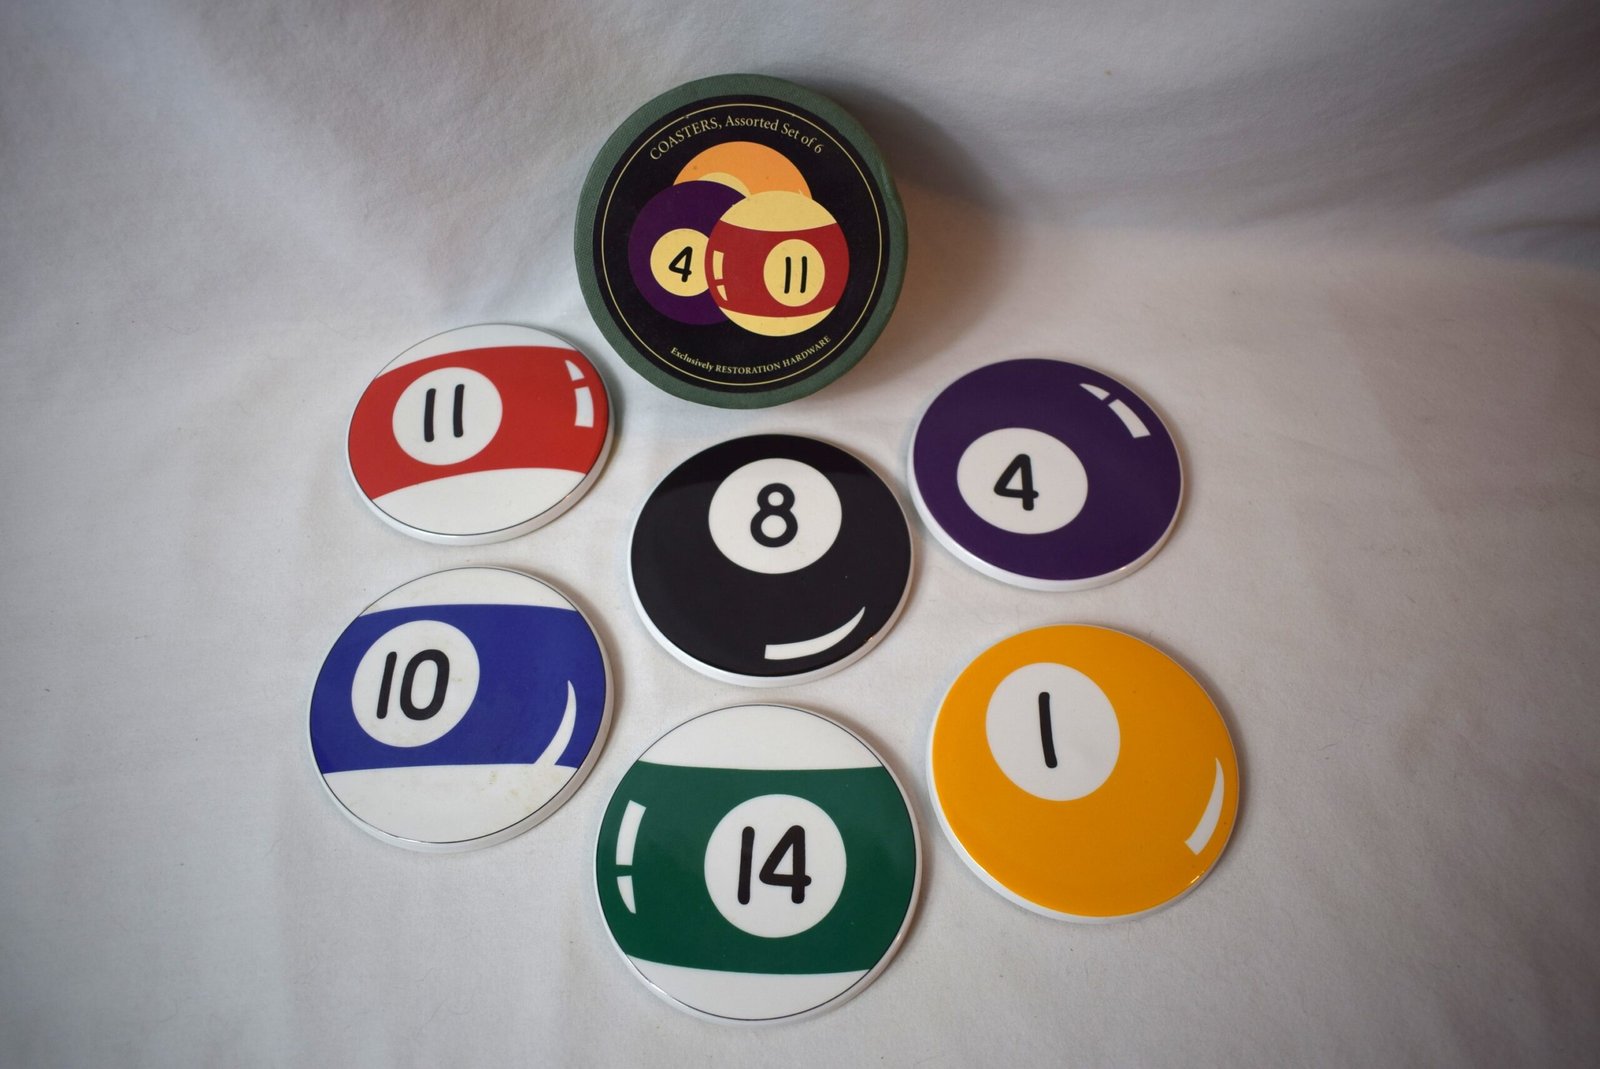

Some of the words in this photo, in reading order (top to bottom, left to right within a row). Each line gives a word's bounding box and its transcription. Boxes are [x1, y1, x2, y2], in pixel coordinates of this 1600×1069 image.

[649, 116, 723, 160] COASTERS,
[725, 115, 779, 131] Assorted
[780, 123, 800, 140] Set
[800, 135, 819, 148] of
[813, 143, 825, 154] 6
[669, 247, 692, 283] 4
[783, 255, 808, 294] 11
[670, 347, 714, 372] Exclusively
[715, 362, 781, 375] RESTORATION
[782, 335, 832, 367] HARDWARE
[423, 383, 465, 443] 11
[993, 453, 1039, 512] 4
[750, 482, 799, 548] 8
[376, 648, 450, 720] 10
[1038, 691, 1058, 769] 1
[737, 824, 812, 906] 14
